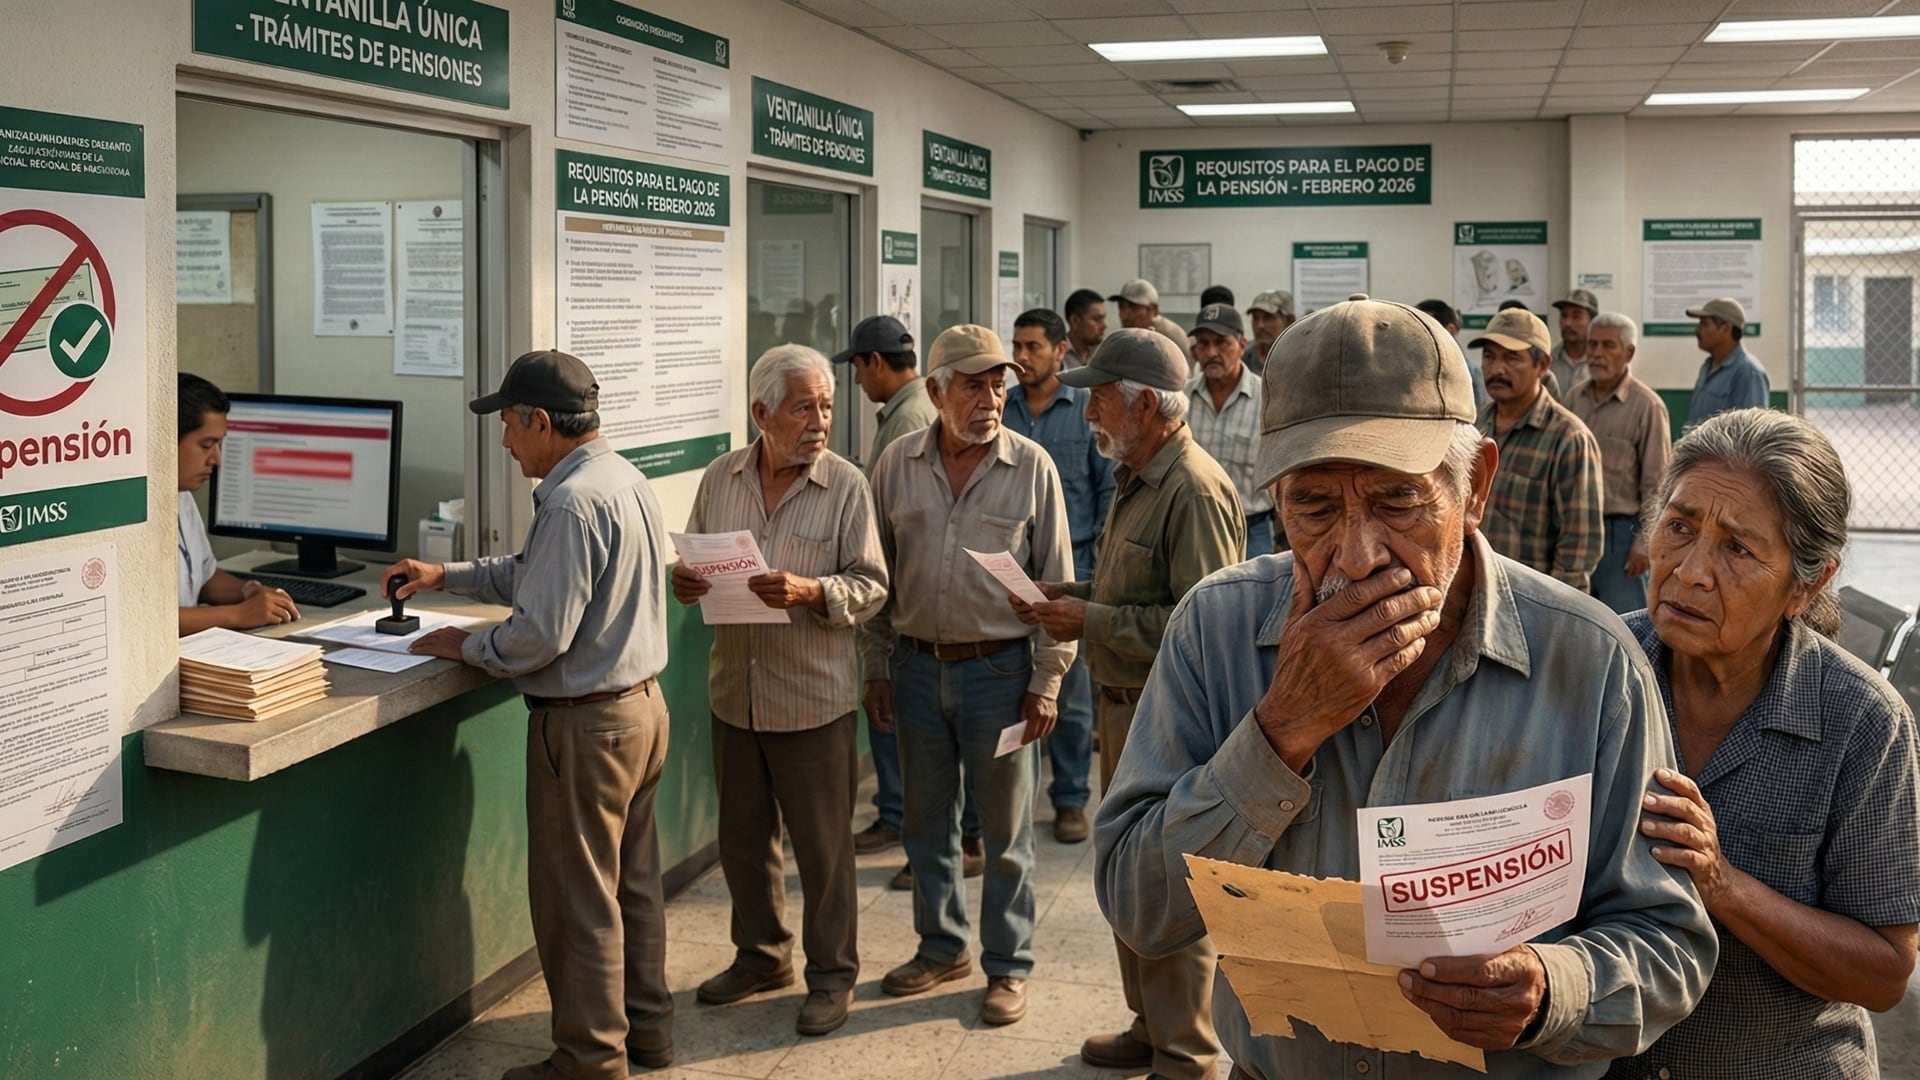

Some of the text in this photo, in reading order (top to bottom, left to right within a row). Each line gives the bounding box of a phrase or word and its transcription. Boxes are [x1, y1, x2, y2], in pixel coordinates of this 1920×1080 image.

[417, 0, 483, 51] ÚNICA
[235, 13, 483, 87] - TRÁMITES DE PENSIONES
[766, 93, 834, 134] VENTANILLA
[835, 108, 864, 141] ÚNICA
[769, 125, 812, 153] TRÁMITES
[811, 137, 824, 156] DE
[568, 161, 720, 197] REQUISITOS PARA EL PAGO DE
[1195, 157, 1425, 178] REQUISITOS PARA EL PAGO DE
[1148, 189, 1185, 203] IMSS
[1197, 181, 1217, 195] LA
[1220, 176, 1288, 195] PENSIÓN
[1302, 179, 1375, 194] FEBRERO
[1378, 178, 1416, 193] 2026
[574, 186, 589, 205] LA
[591, 188, 639, 210] PENSIÓN
[647, 195, 692, 215] FEBRERO
[693, 201, 716, 217] 2026
[27, 502, 68, 525] IMSS
[1377, 837, 1406, 848] IMSS
[1391, 840, 1565, 903] SUSPENSIÓN
